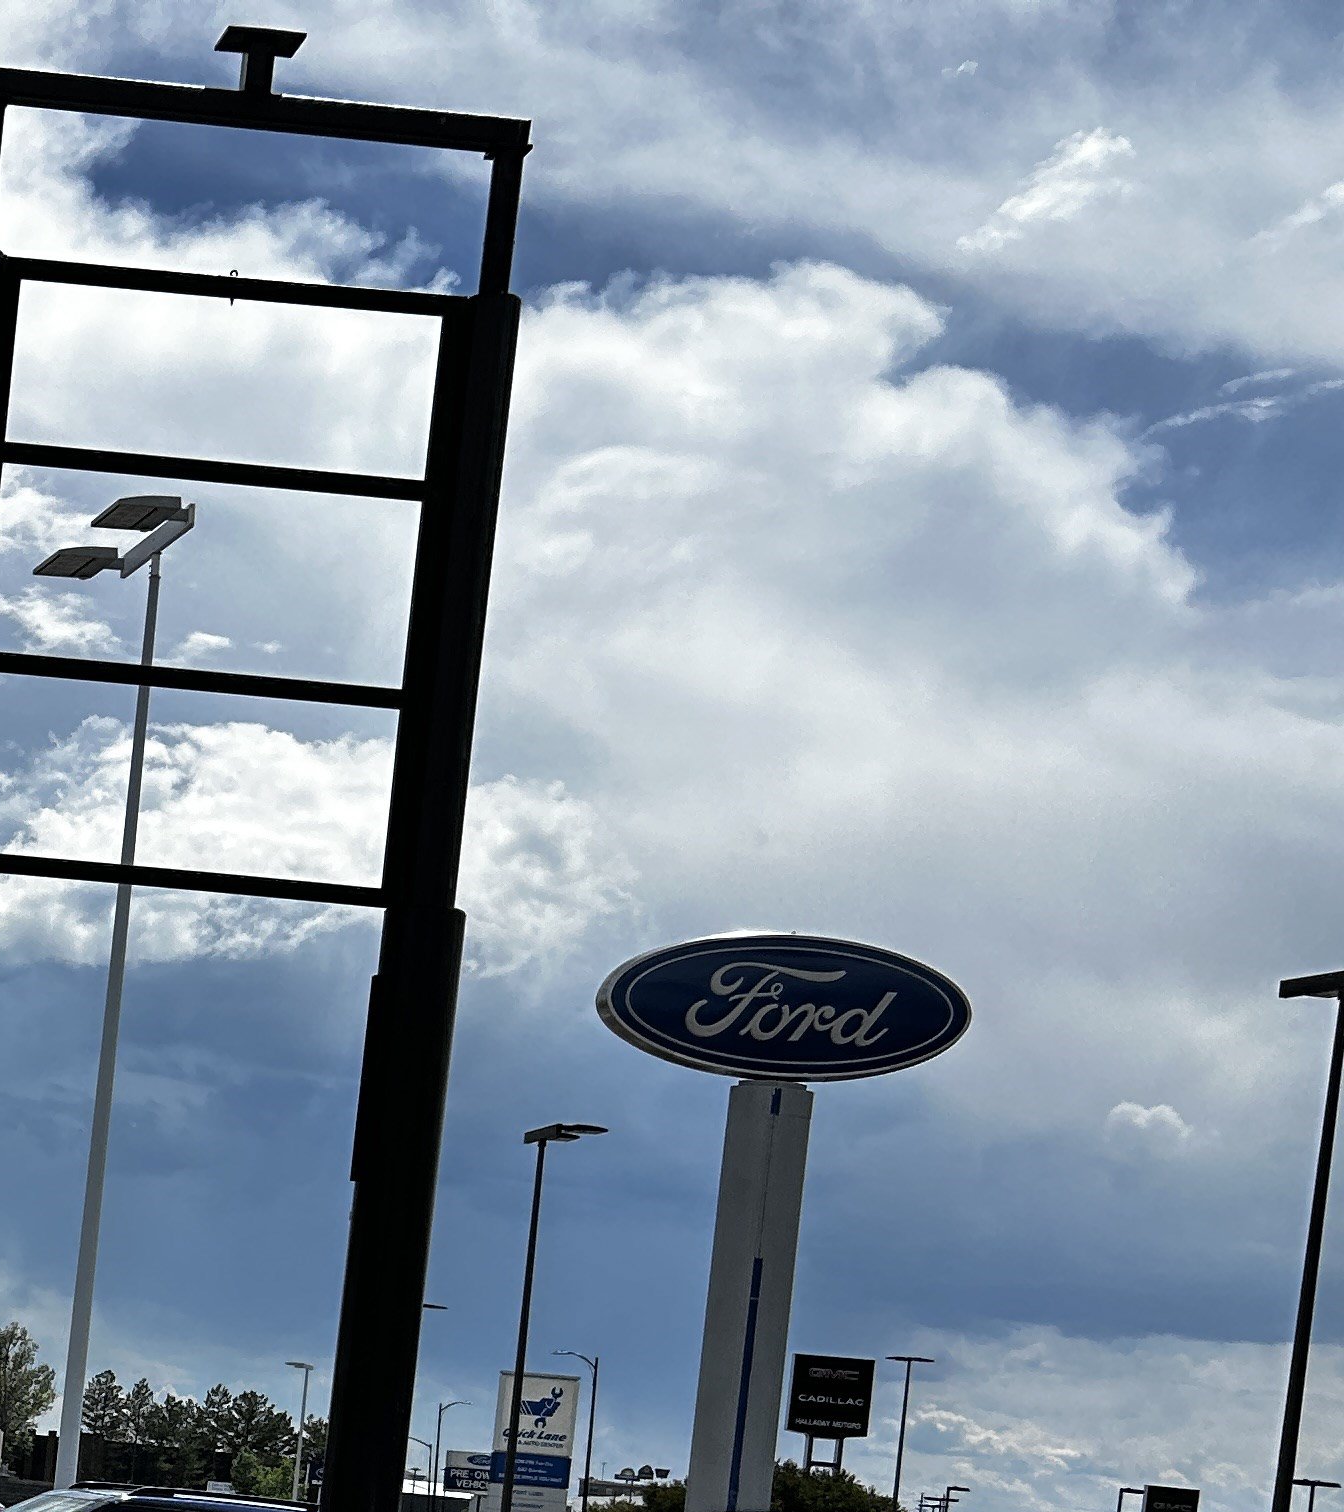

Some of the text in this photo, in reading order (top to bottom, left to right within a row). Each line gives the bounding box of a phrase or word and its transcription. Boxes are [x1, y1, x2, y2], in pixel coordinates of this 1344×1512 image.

[685, 961, 898, 1048] Ford
[808, 1367, 860, 1381] GMC
[798, 1393, 865, 1407] CADILLAC
[502, 1428, 568, 1442] Qick Lane
